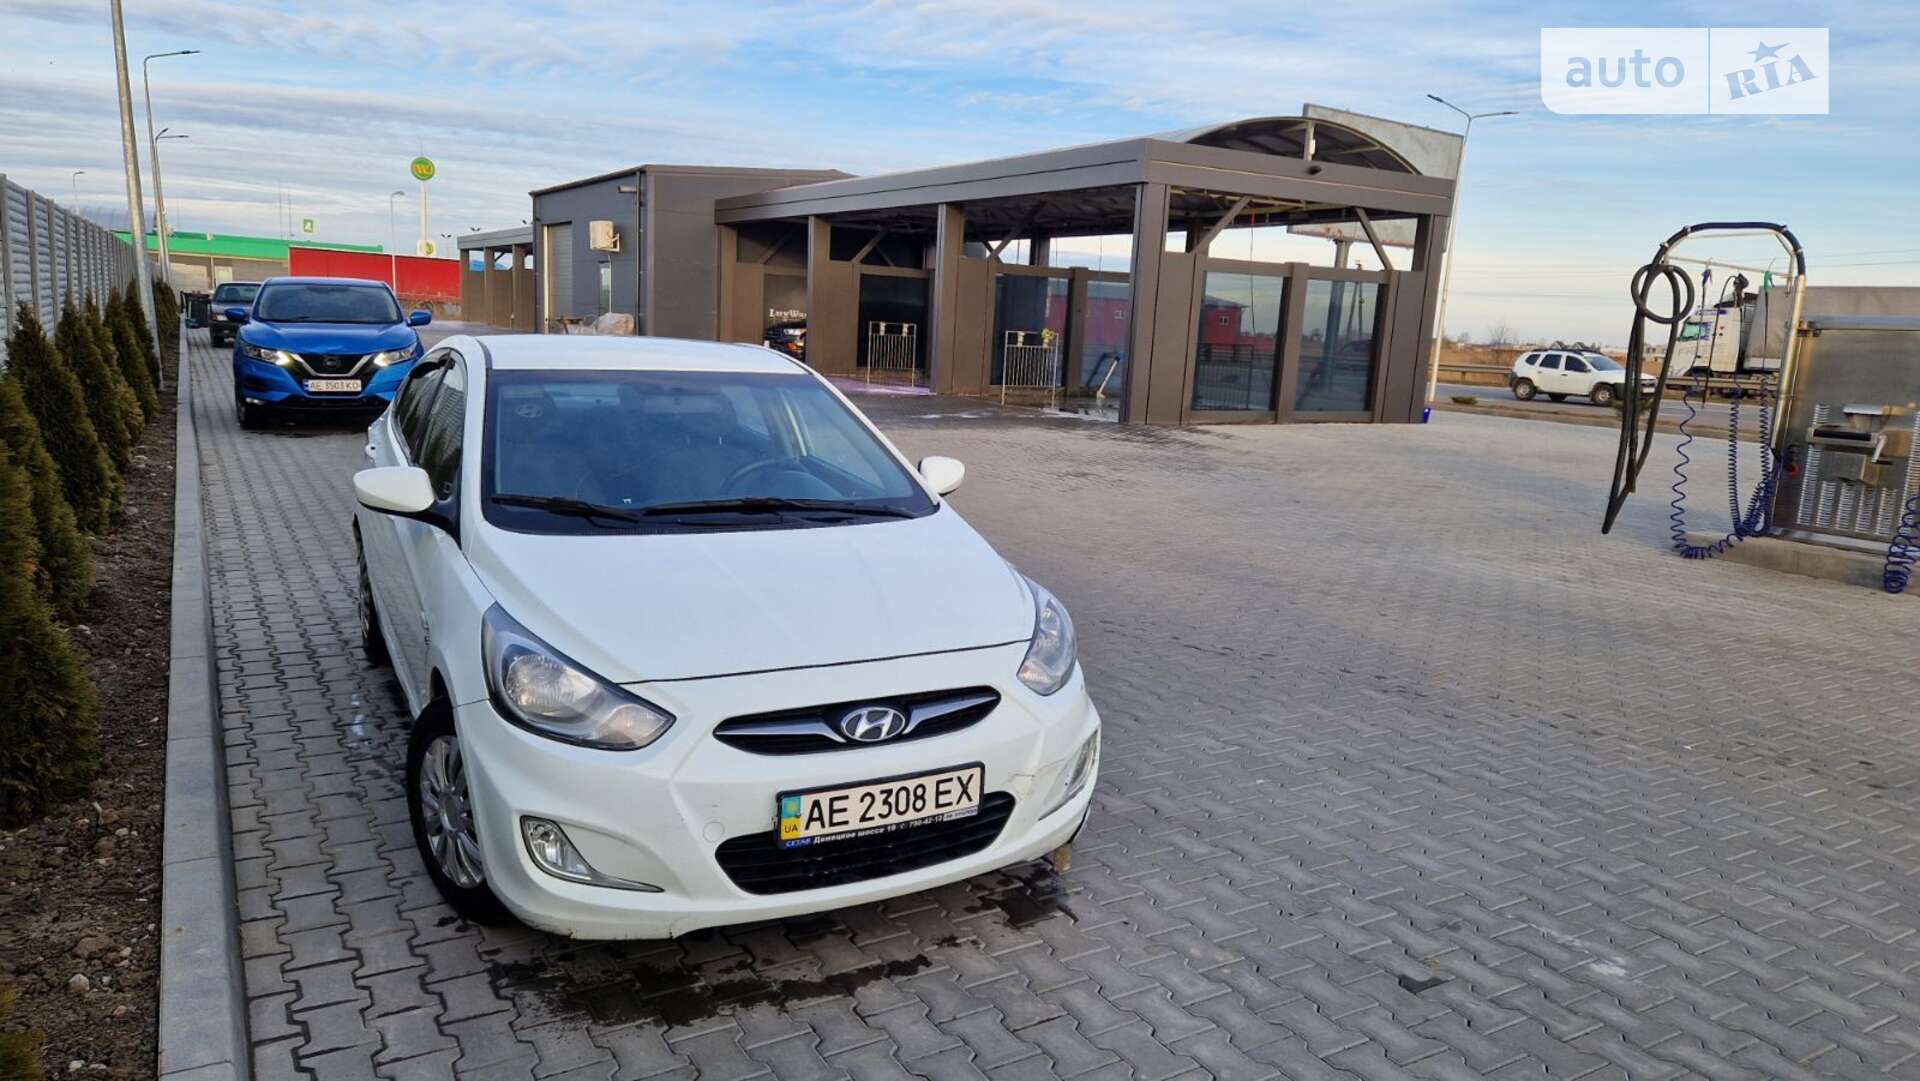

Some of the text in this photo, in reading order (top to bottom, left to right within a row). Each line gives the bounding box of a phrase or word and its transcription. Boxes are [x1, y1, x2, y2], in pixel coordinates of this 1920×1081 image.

[804, 773, 975, 832] AE 2308 EX
[784, 824, 799, 834] UA
